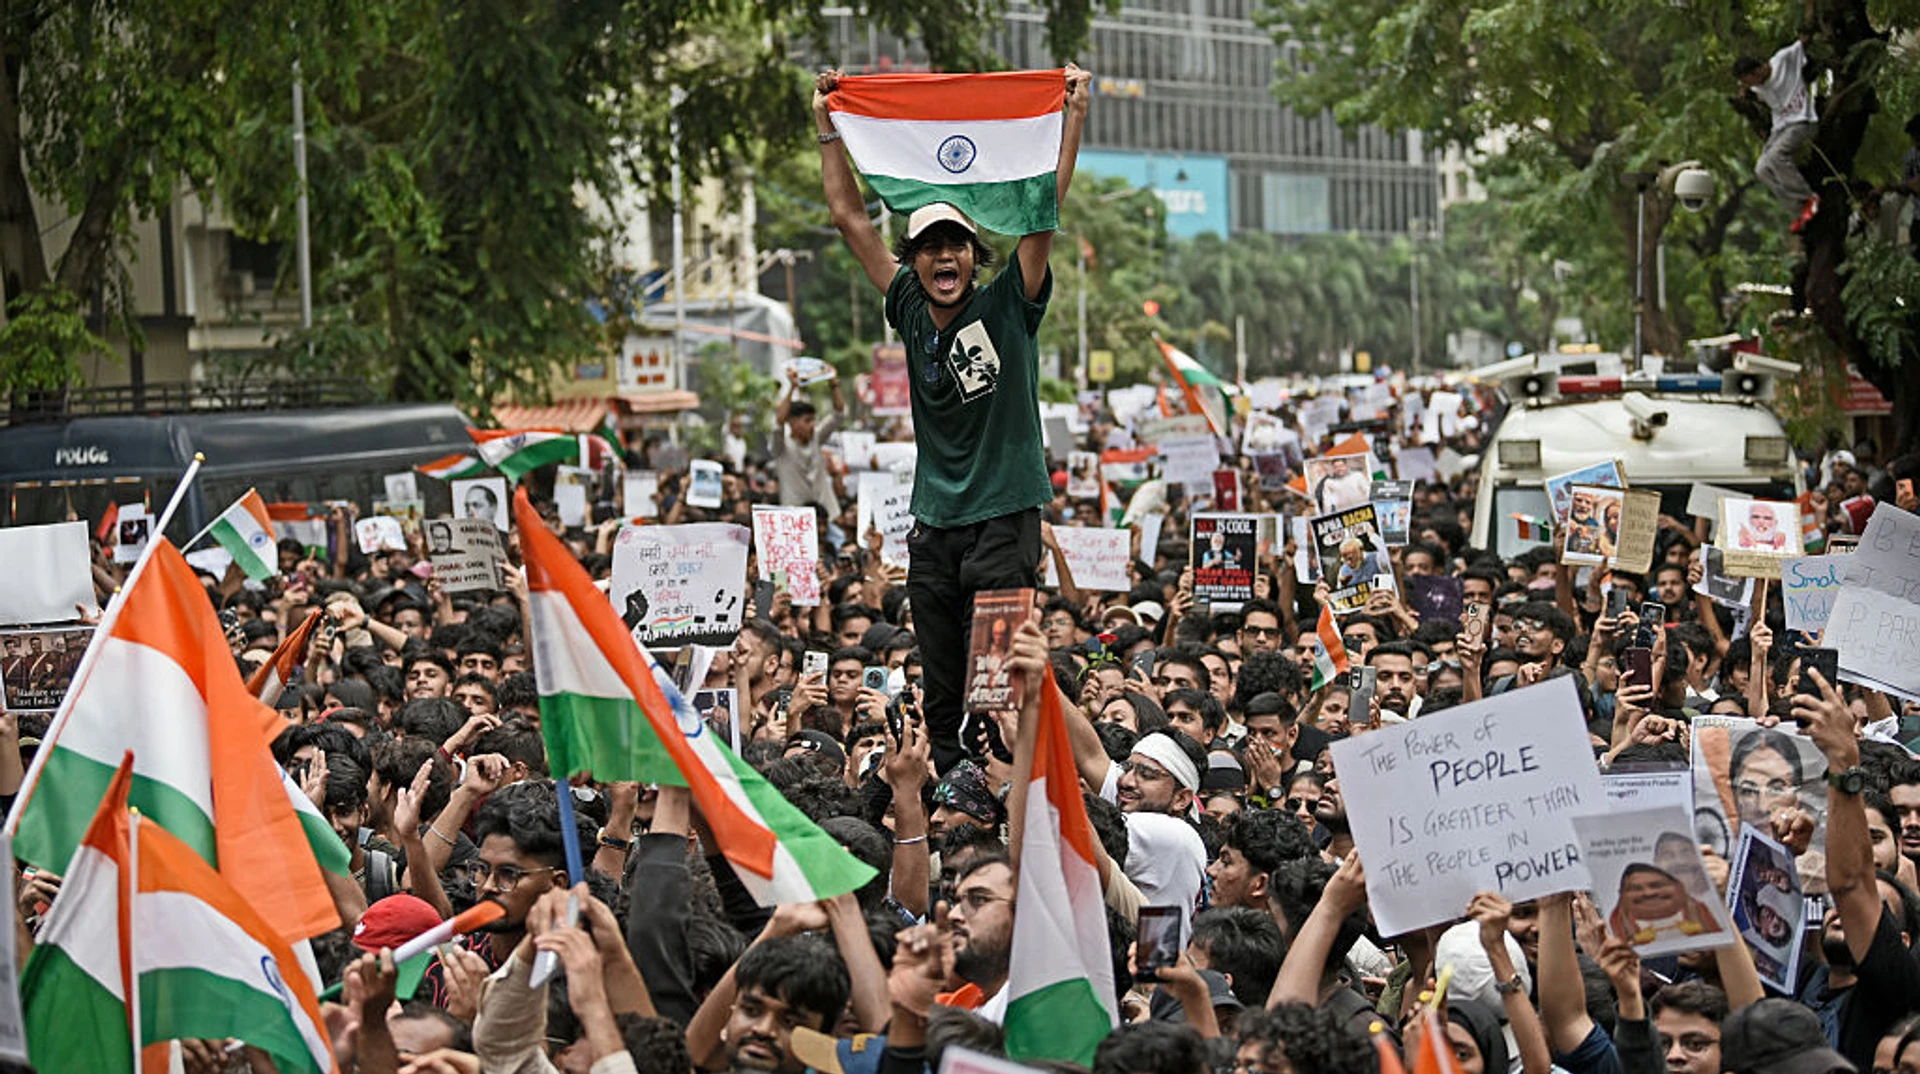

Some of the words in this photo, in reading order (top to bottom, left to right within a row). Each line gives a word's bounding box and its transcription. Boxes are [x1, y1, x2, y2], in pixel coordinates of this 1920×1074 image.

[1226, 521, 1253, 534] COOL
[1429, 746, 1540, 796] PEOPLE
[1388, 815, 1415, 848] IS
[1422, 801, 1517, 838] GREATER
[1523, 784, 1581, 818] THAN
[1380, 859, 1419, 892] THE
[1424, 845, 1492, 877] PEOPLE
[1506, 828, 1531, 852] IN
[1494, 842, 1582, 891] POWER
